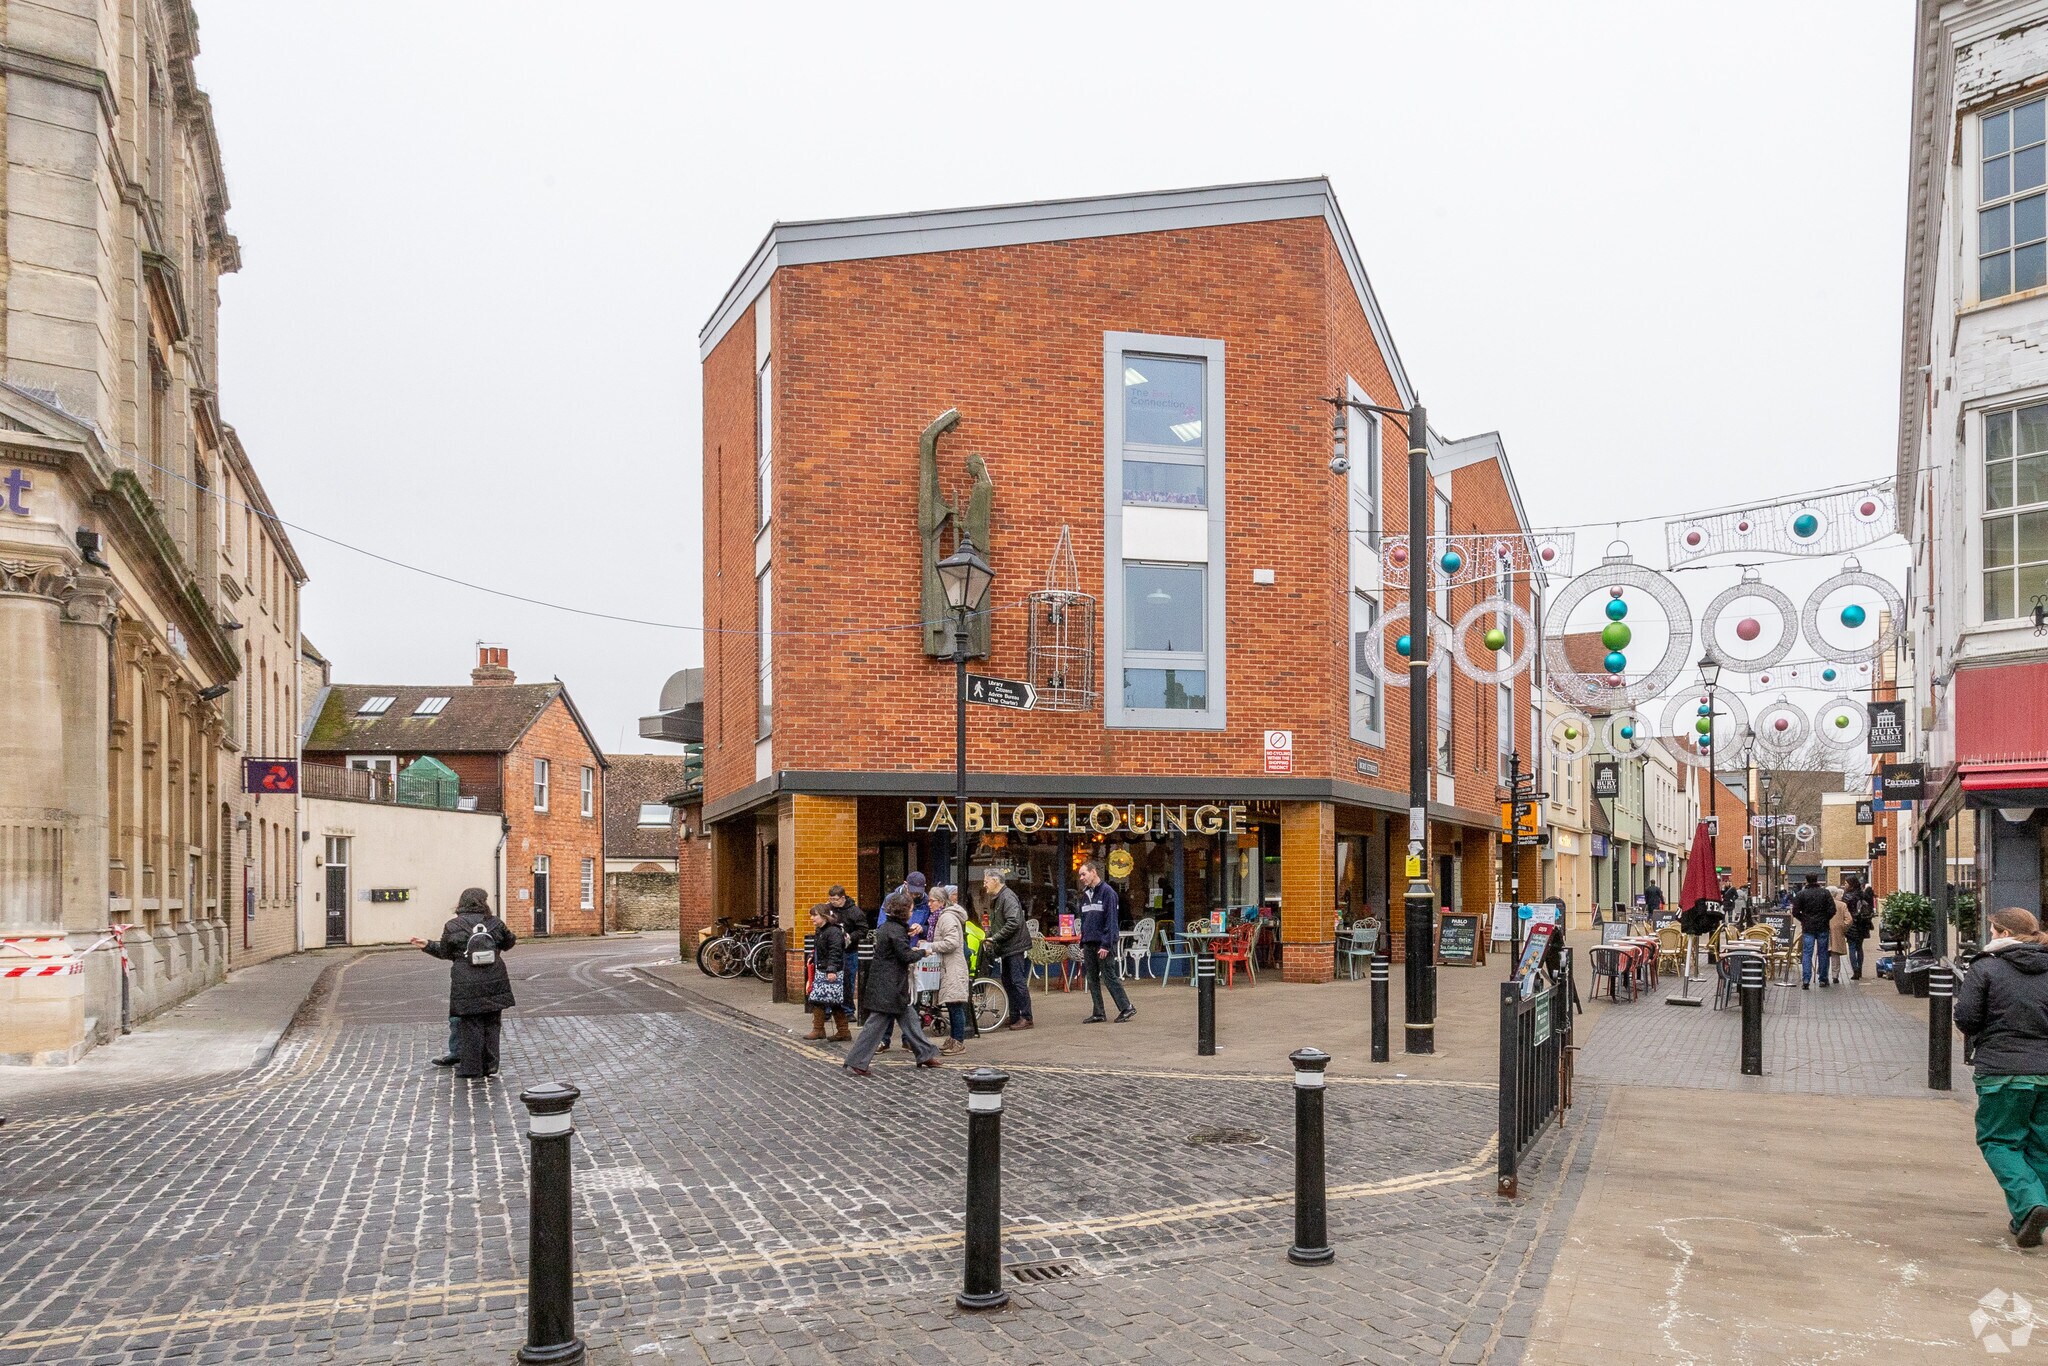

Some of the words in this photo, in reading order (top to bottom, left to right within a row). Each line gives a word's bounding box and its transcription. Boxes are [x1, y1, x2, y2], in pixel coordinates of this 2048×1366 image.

[1131, 397, 1186, 408] Connection
[0, 469, 32, 516] t
[1871, 728, 1902, 736] BURY
[906, 800, 1045, 834] PABLO
[1068, 803, 1247, 836] LOUNGE
